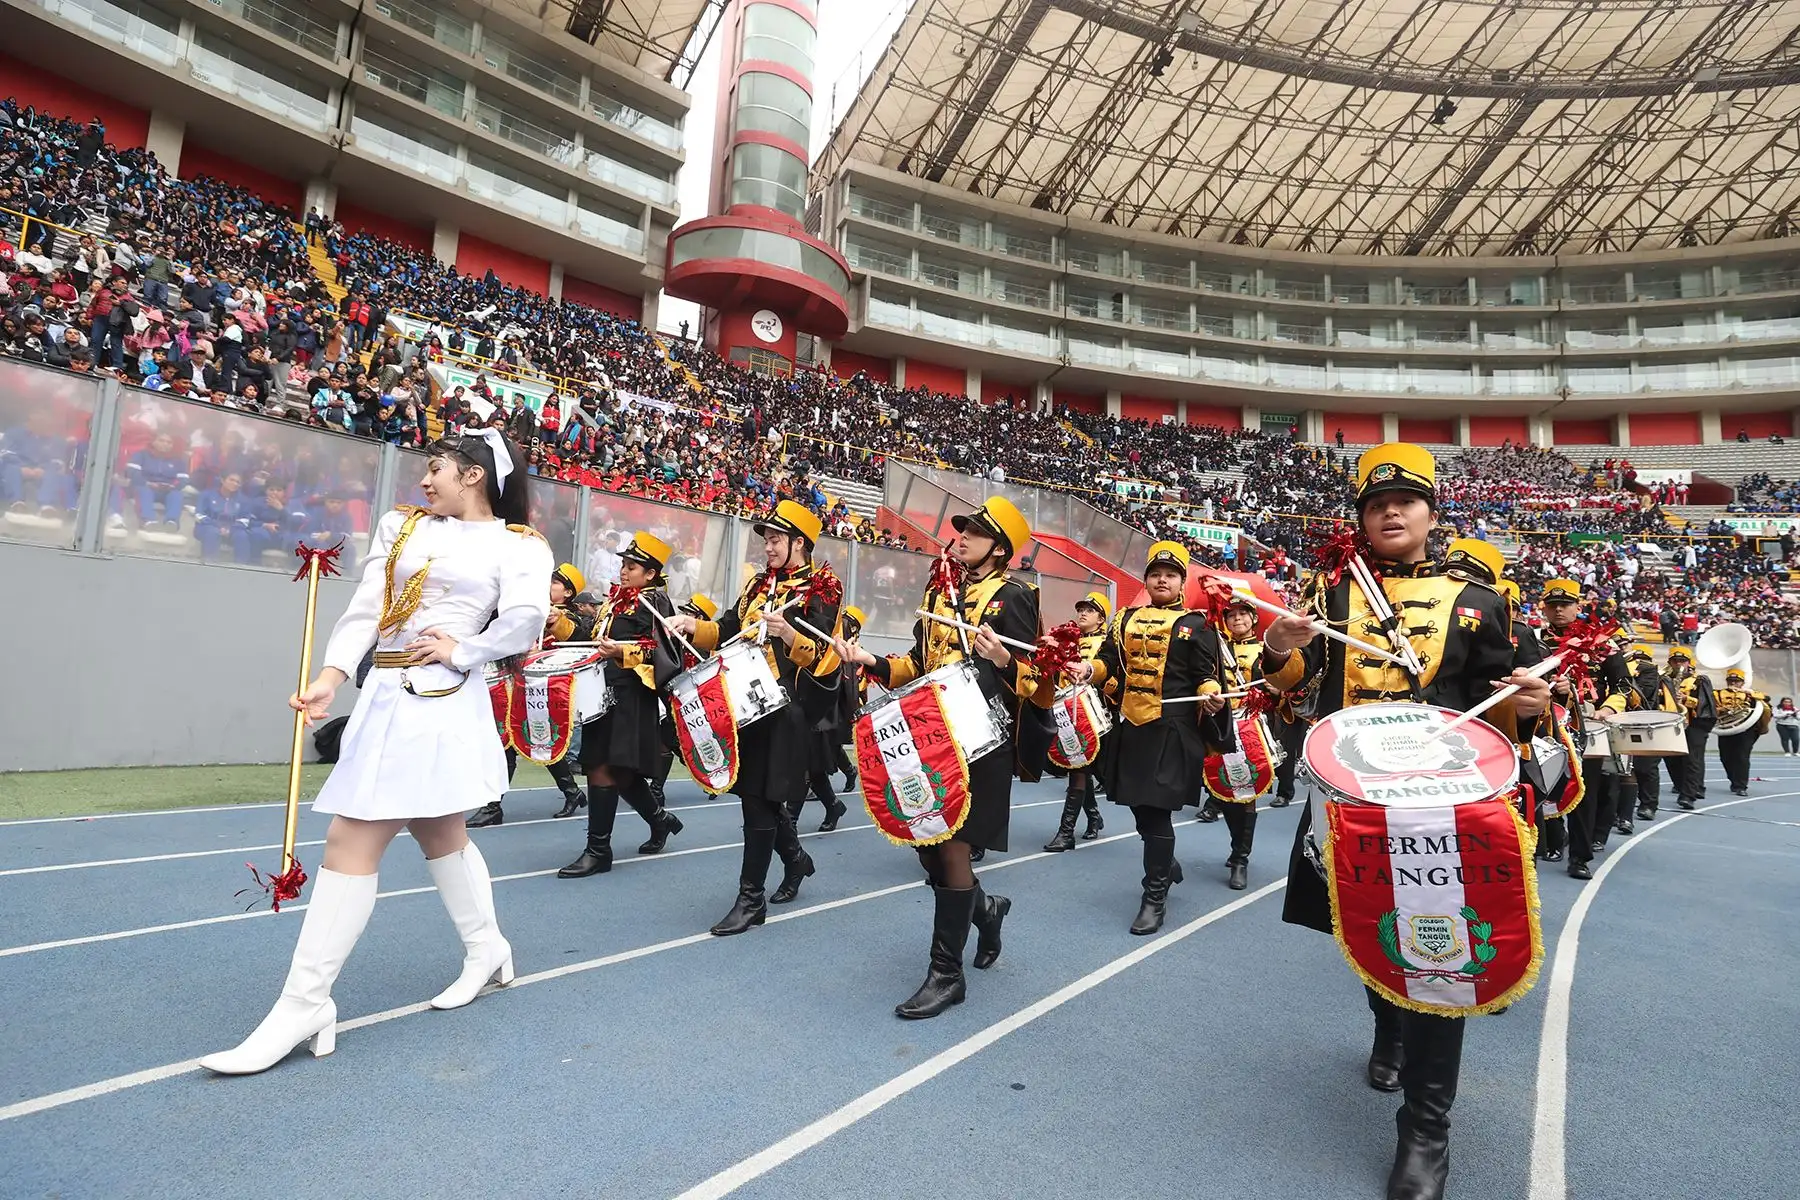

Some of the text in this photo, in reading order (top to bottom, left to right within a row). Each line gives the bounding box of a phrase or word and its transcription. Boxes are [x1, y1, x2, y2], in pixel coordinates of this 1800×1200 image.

[1458, 615, 1481, 633] FT
[862, 712, 928, 748] FERMIN
[1343, 711, 1431, 728] FERMÍN
[861, 729, 944, 770] TANGUIS
[1366, 781, 1488, 799] TANGÜIS
[1358, 832, 1492, 854] FERMIN
[1352, 863, 1512, 887] TANGUIS
